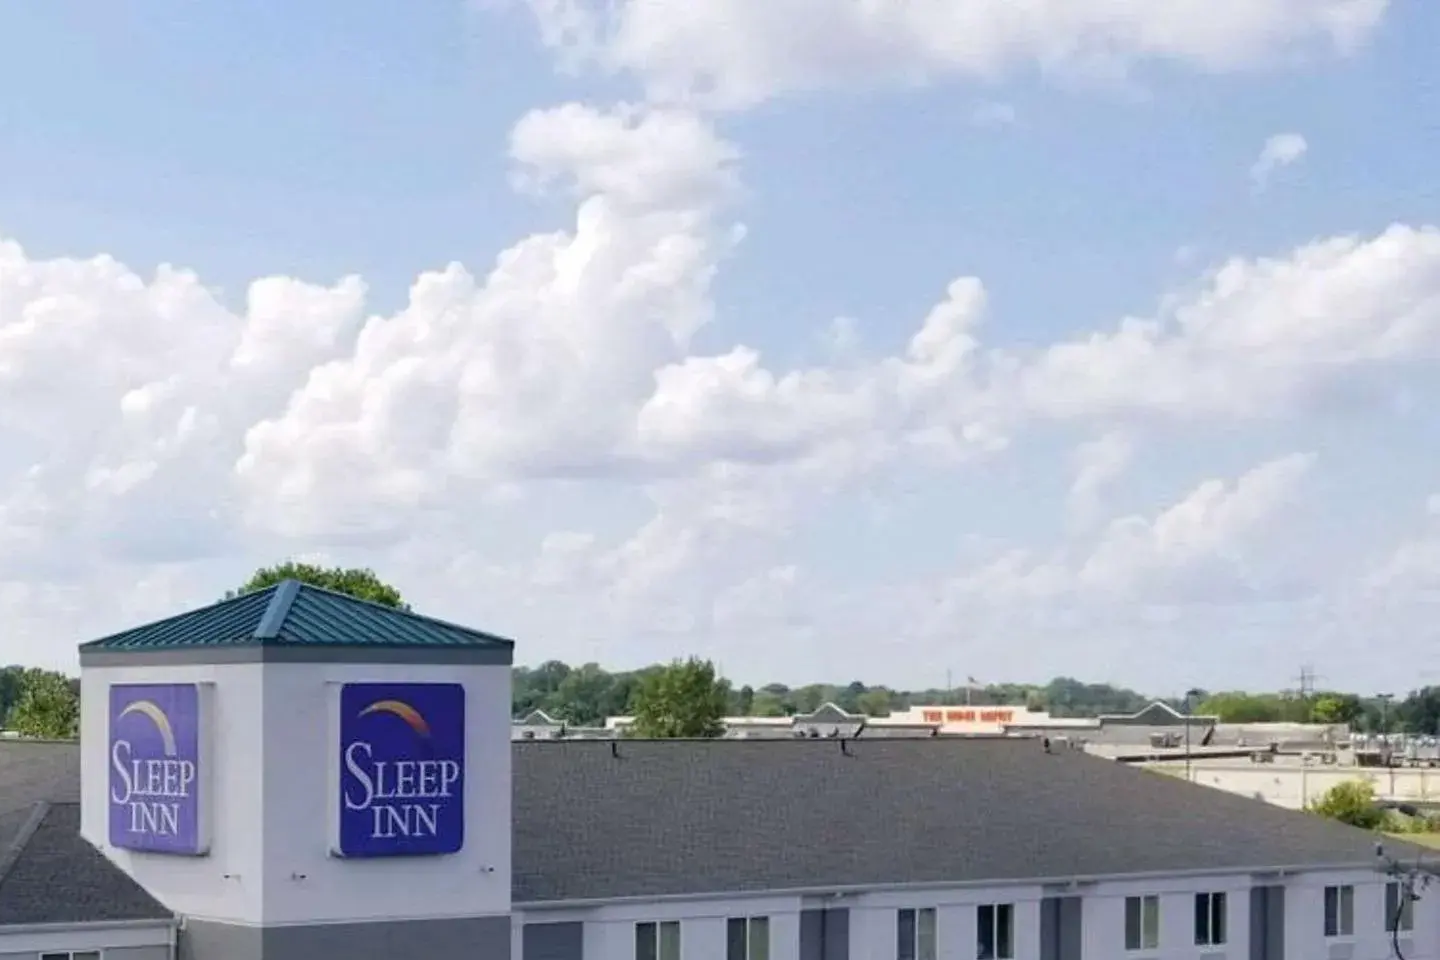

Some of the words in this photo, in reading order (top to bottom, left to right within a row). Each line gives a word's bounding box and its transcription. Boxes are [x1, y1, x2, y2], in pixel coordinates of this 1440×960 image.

[111, 740, 195, 805] SLEEP
[344, 741, 460, 810] SLEEP
[128, 802, 181, 836] INN
[371, 803, 440, 839] INN
